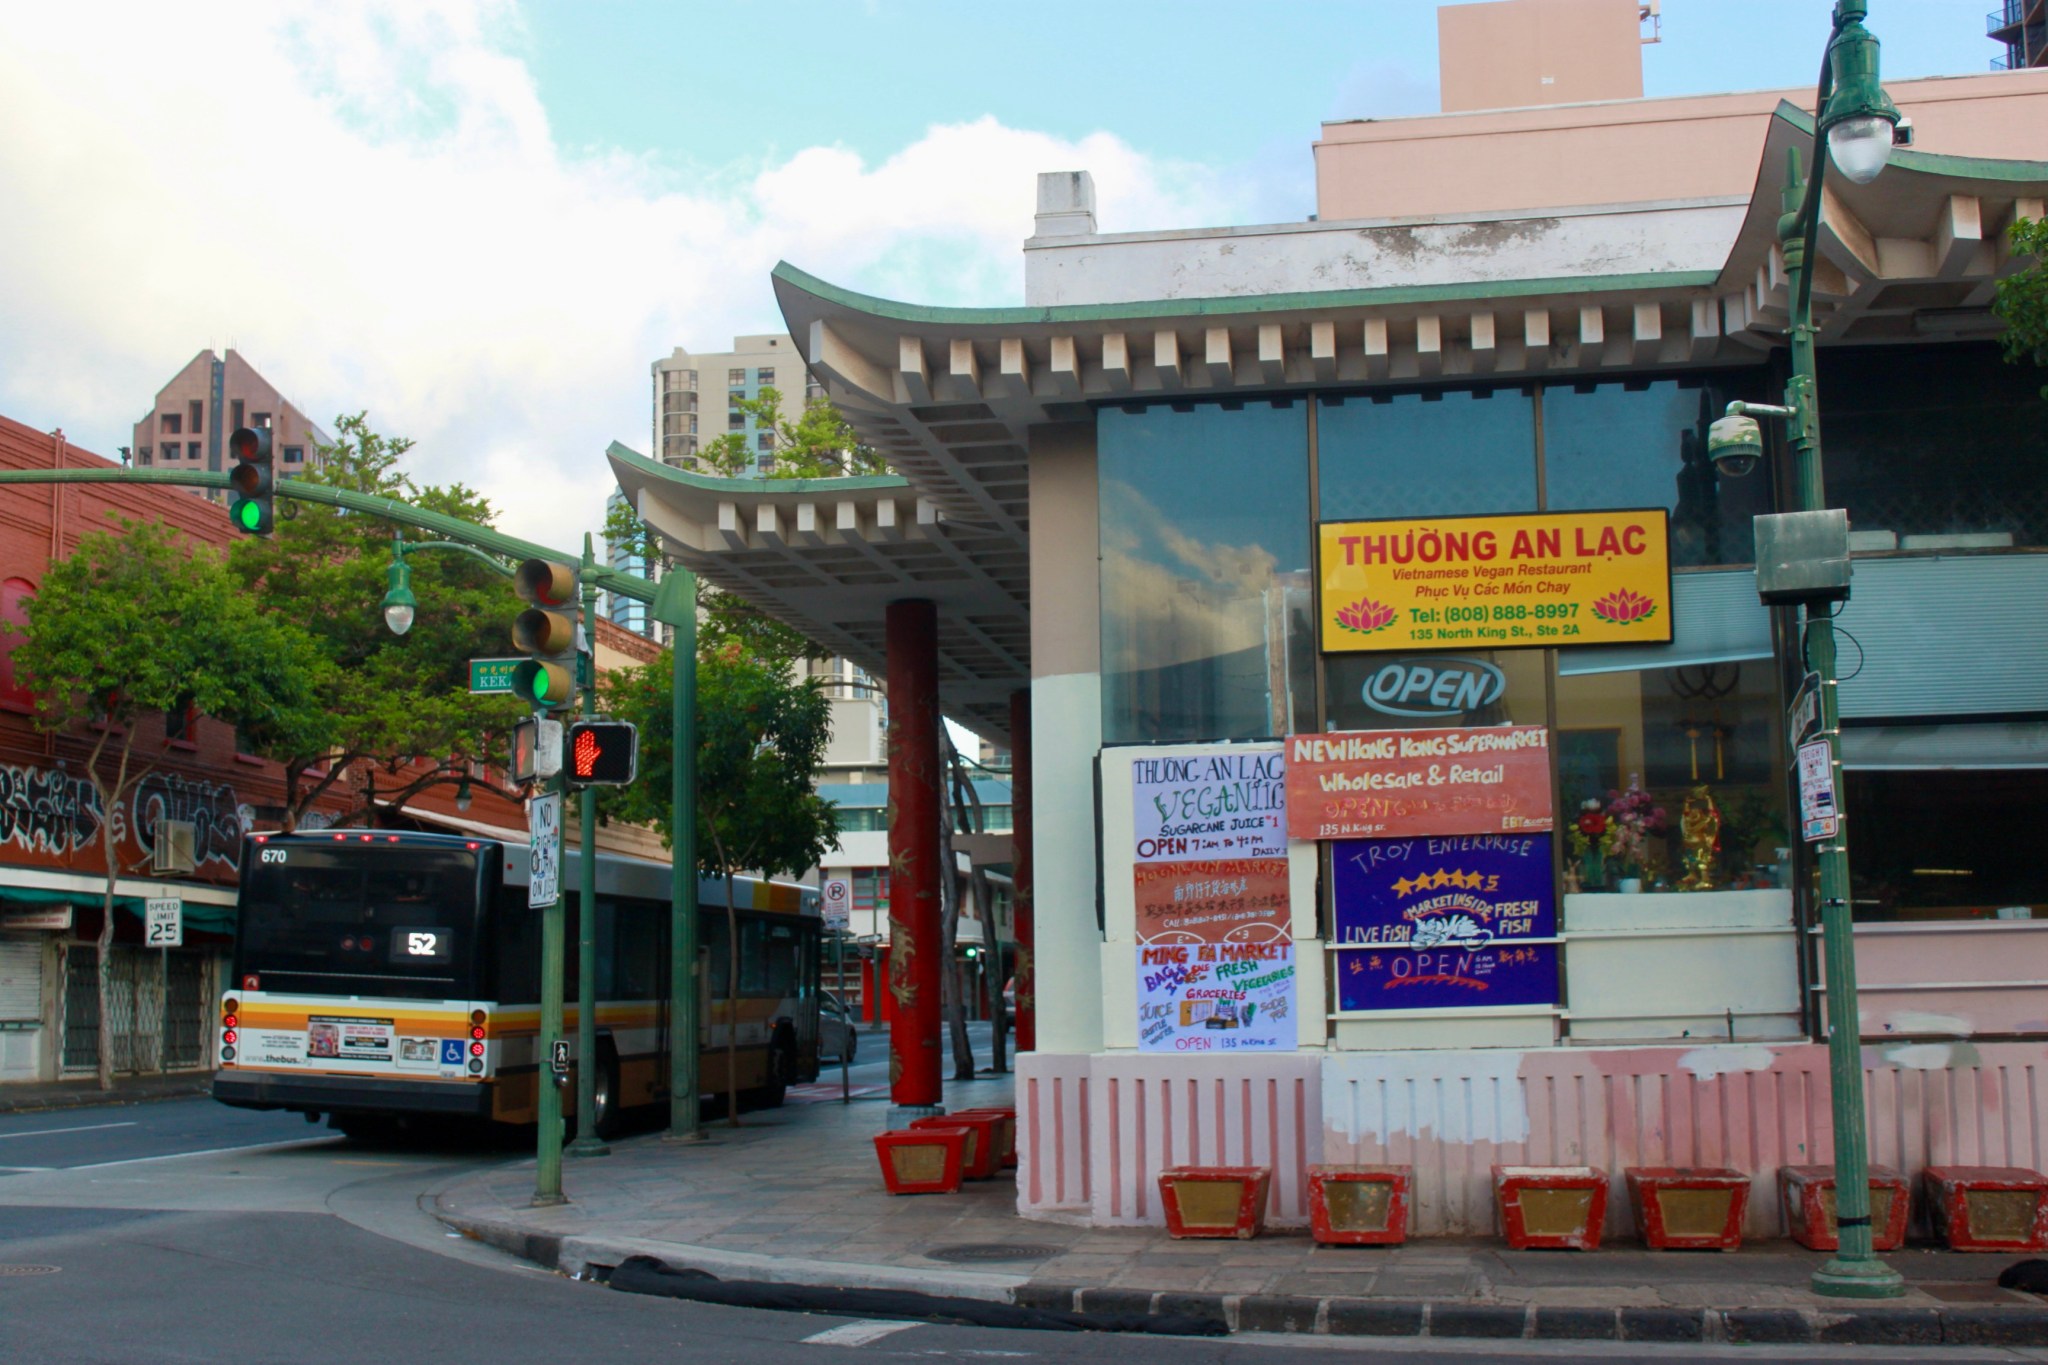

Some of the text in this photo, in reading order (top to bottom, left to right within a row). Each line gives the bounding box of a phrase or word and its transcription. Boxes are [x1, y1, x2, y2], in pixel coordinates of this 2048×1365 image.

[1510, 528, 1561, 560] AN
[1392, 562, 1592, 580] Vietnamese Vegan Restaurant
[1536, 581, 1571, 595] Chay
[1409, 603, 1579, 624] Tel: (808) 888-8997
[1410, 629, 1433, 640] 135
[1437, 627, 1473, 639] North
[1477, 626, 1507, 639] King
[1536, 625, 1558, 636] Ste
[1562, 624, 1580, 635] 2A
[480, 676, 512, 687] KEK
[1372, 664, 1491, 709] OPEN
[1294, 739, 1348, 762] NEW
[1348, 737, 1396, 760] HONG
[1400, 737, 1447, 759] KONG
[1204, 756, 1232, 781] AN
[1319, 764, 1504, 792] Wholesale & Retail
[540, 803, 552, 828] NO
[1502, 816, 1524, 829] EBT
[1159, 821, 1225, 837] SUGARCANE
[1230, 817, 1264, 831] JUICE
[1319, 824, 1338, 835] 135
[261, 849, 287, 863] 670
[1136, 837, 1187, 858] OPEN
[1350, 836, 1533, 873] TROY ENTERPRISE
[149, 902, 179, 911] SPEED
[1407, 893, 1494, 918] MARKET INSIDE
[1495, 900, 1539, 918] FRESH
[153, 912, 175, 920] LIMIT
[150, 923, 177, 940] 25
[1345, 925, 1412, 943] LIVE FISH
[1500, 919, 1532, 935] FISH
[408, 932, 437, 955] 52
[1142, 941, 1292, 966] MING FA MARKET
[1216, 960, 1259, 981] FRESH
[1391, 953, 1473, 978] OPEN
[1232, 965, 1295, 992] VEGETABLES
[1186, 988, 1247, 1000] GROCERIES
[1140, 1001, 1174, 1021] JUICE
[1175, 1037, 1211, 1050] OPEN
[1221, 1037, 1237, 1048] 135
